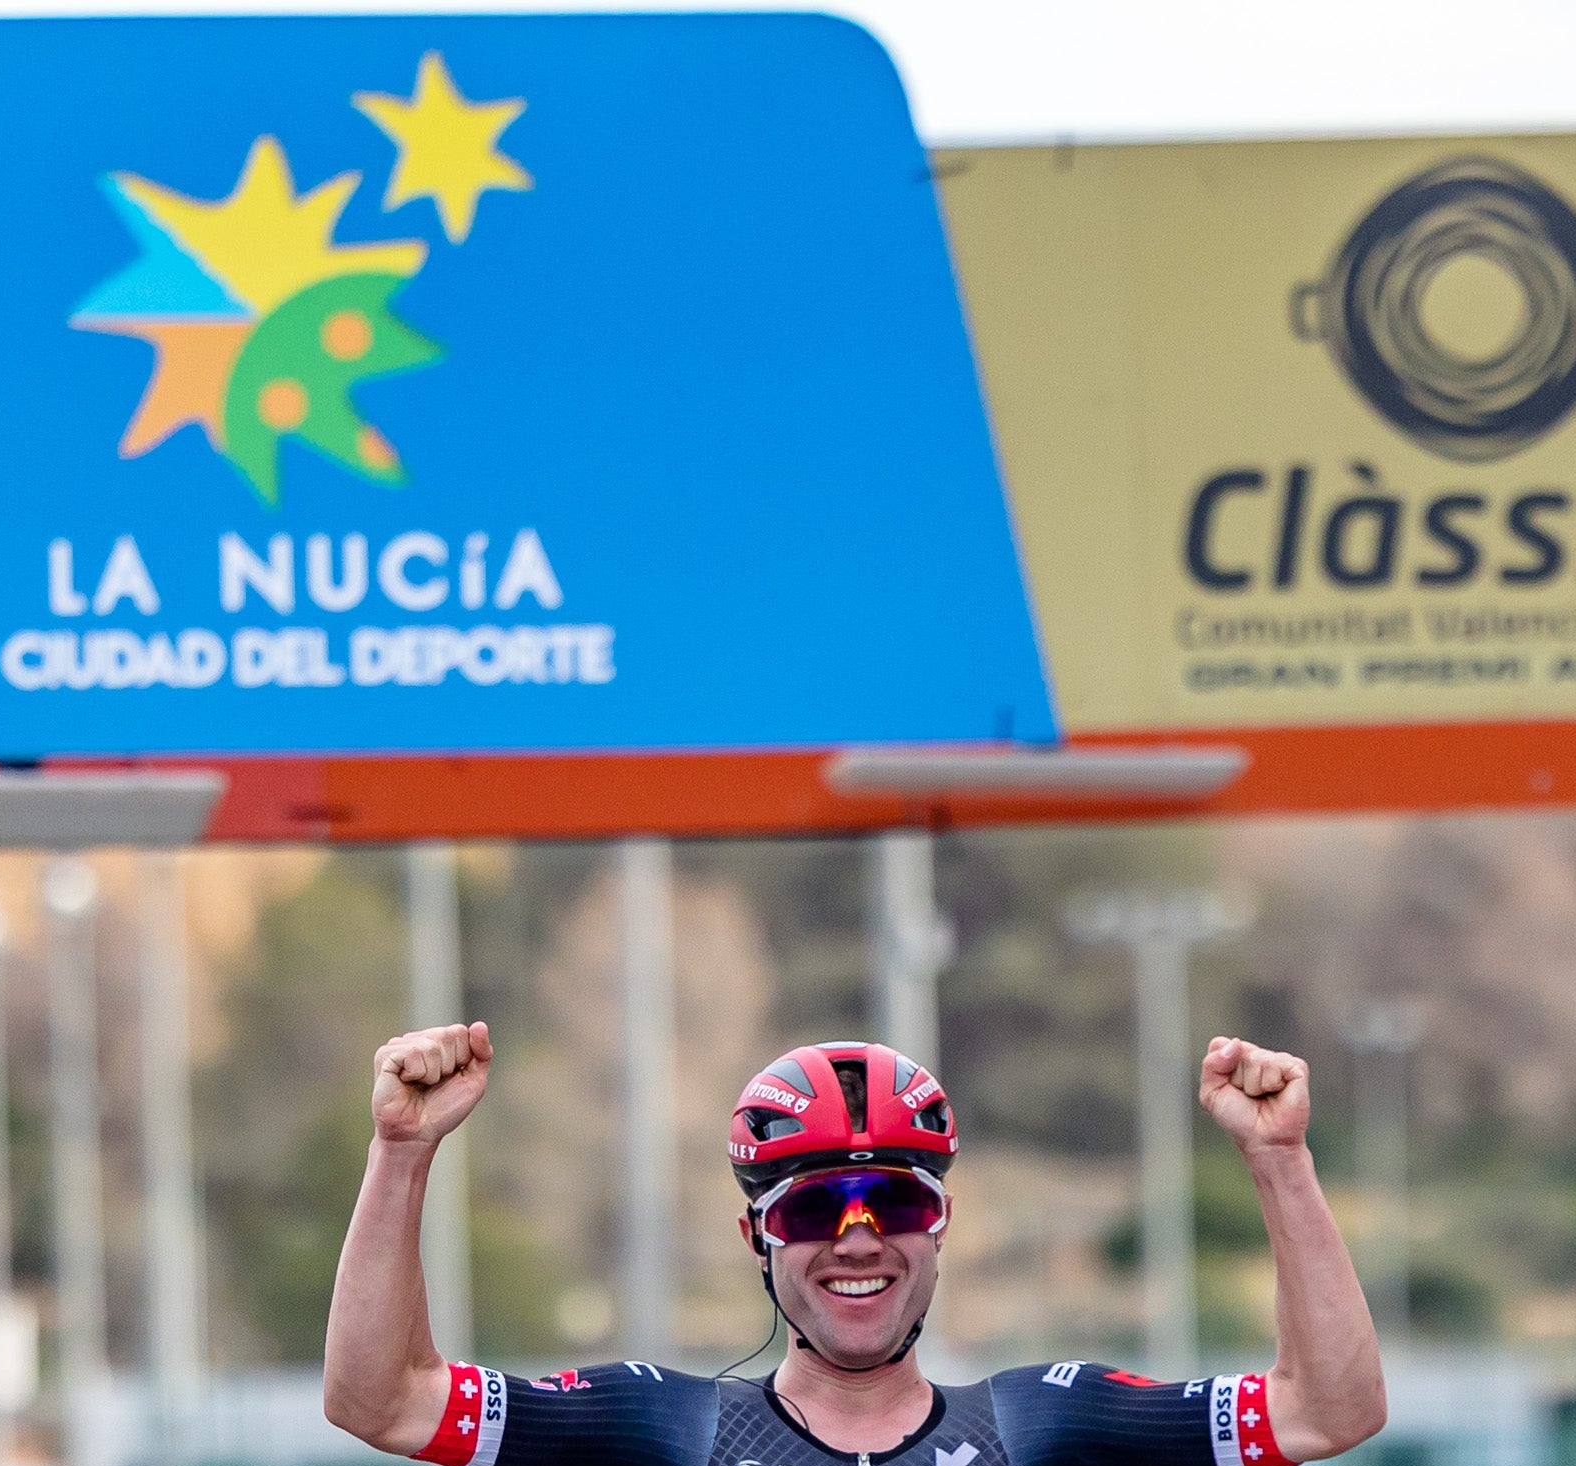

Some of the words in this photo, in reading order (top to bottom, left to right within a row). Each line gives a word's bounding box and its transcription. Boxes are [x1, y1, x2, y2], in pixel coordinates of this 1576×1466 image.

[46, 532, 161, 617] LA
[0, 627, 227, 691] CIUDAD
[229, 625, 345, 689] DEL
[347, 622, 616, 686] DEPORTE
[756, 1084, 796, 1108] TUDOR
[485, 1370, 502, 1422] BOSS
[1216, 1386, 1233, 1442] BOSS
